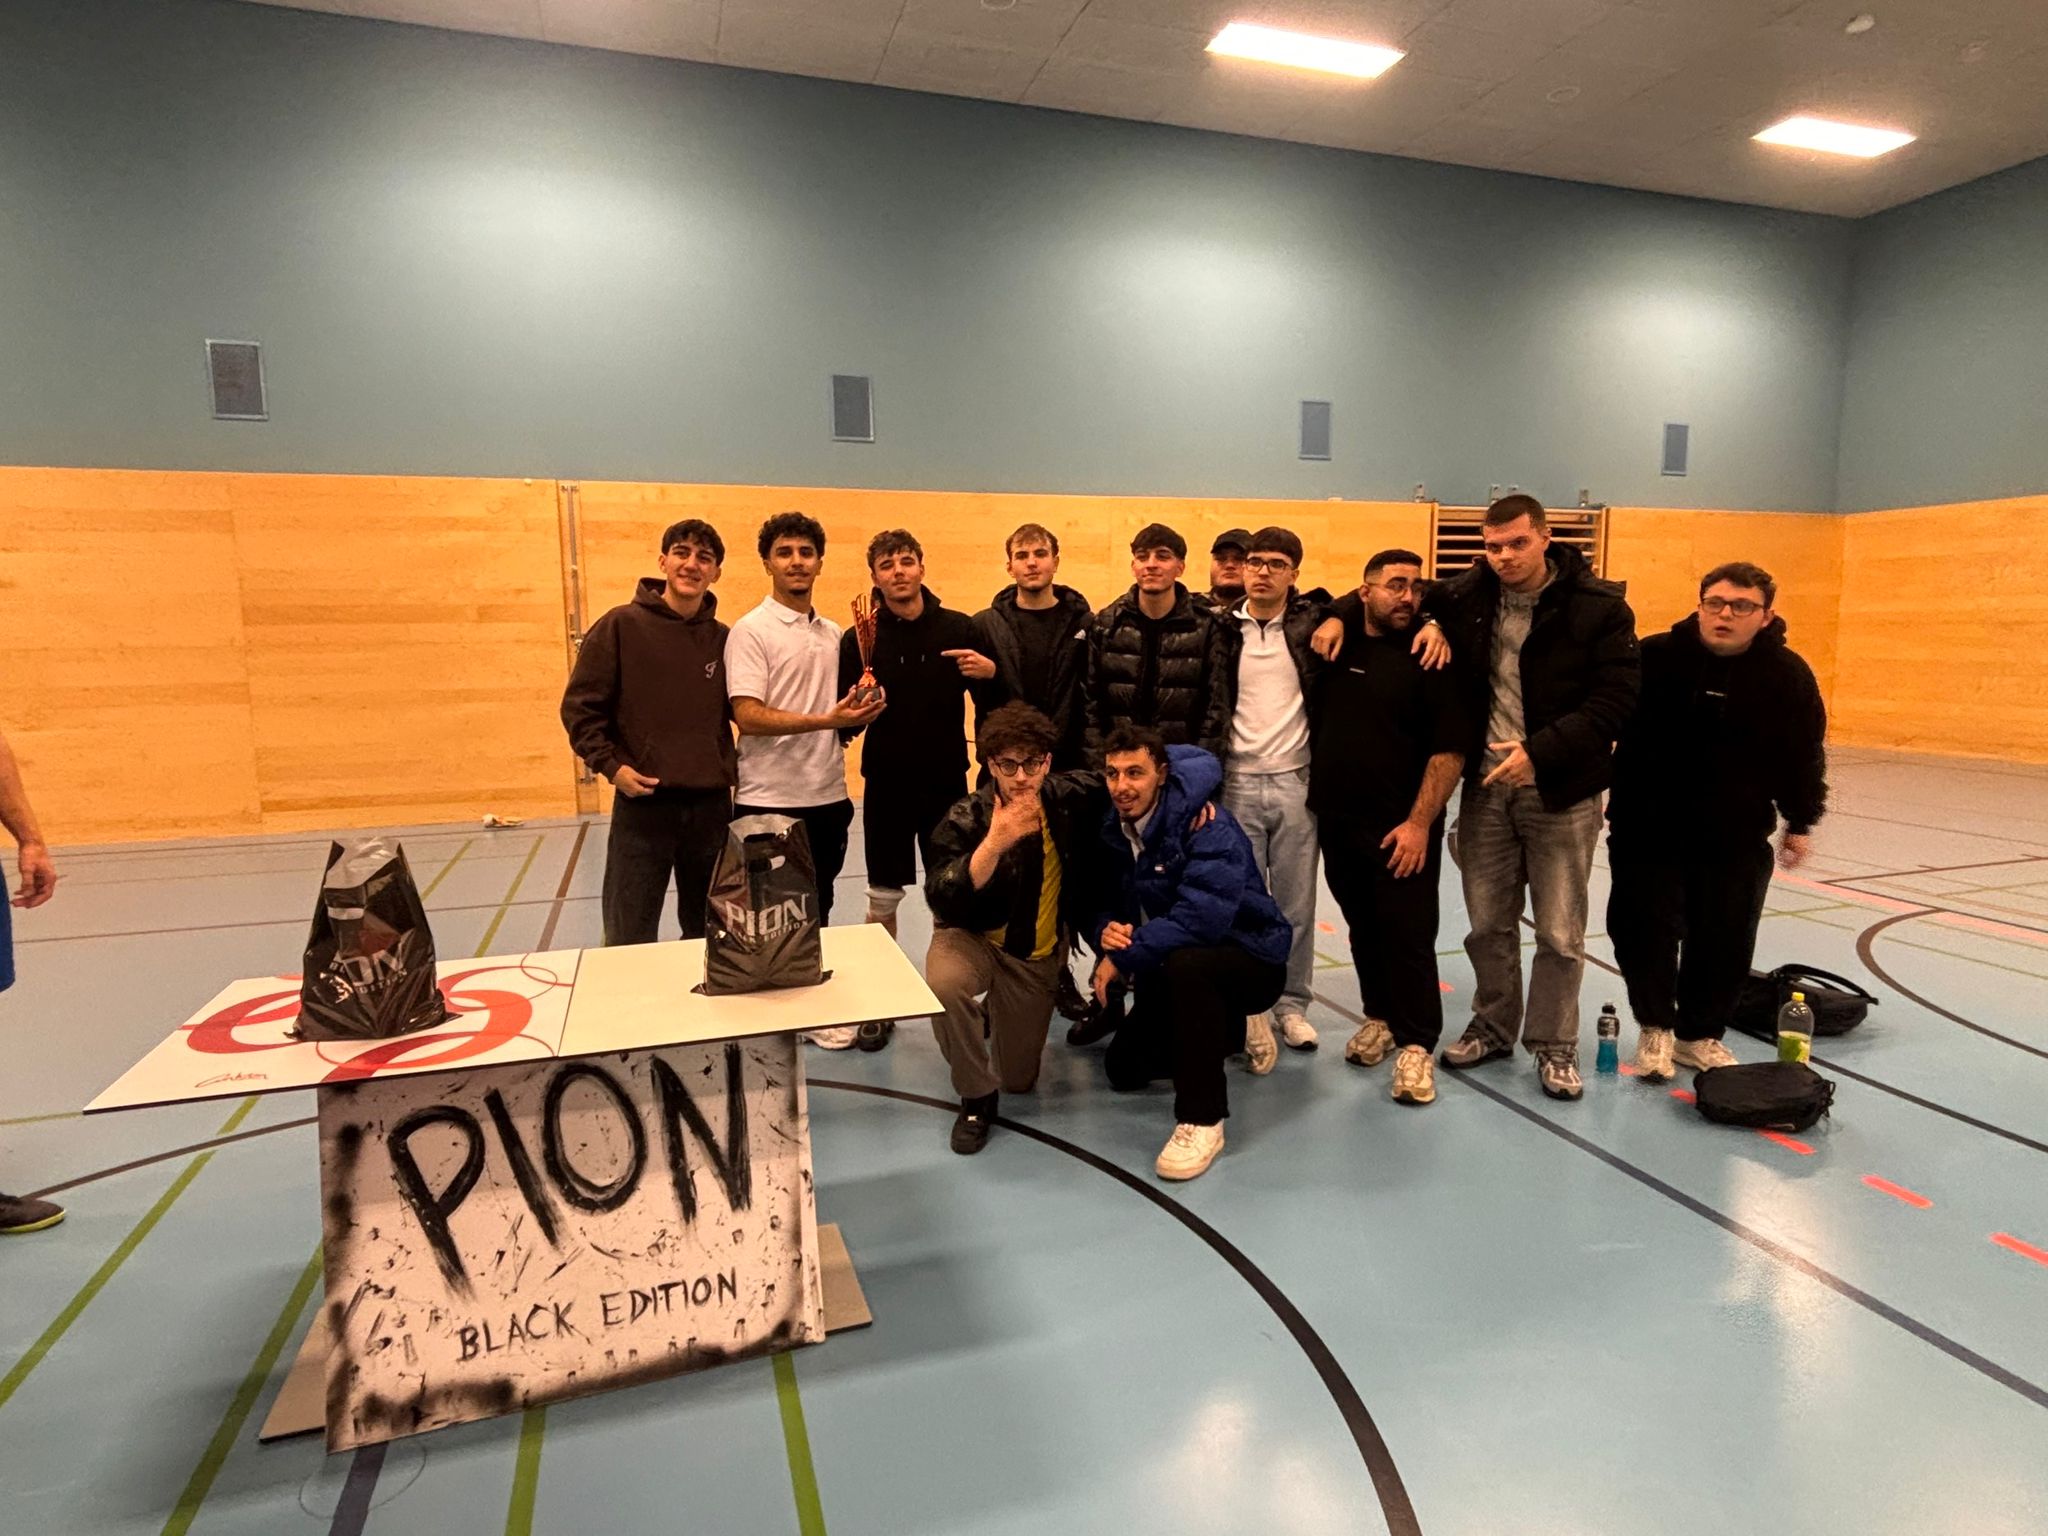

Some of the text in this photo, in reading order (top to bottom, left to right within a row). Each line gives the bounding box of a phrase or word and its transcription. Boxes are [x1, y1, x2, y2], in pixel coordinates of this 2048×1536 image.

[725, 893, 807, 936] PION
[387, 1040, 752, 1300] PION
[456, 1267, 738, 1362] BLACK EDITION
